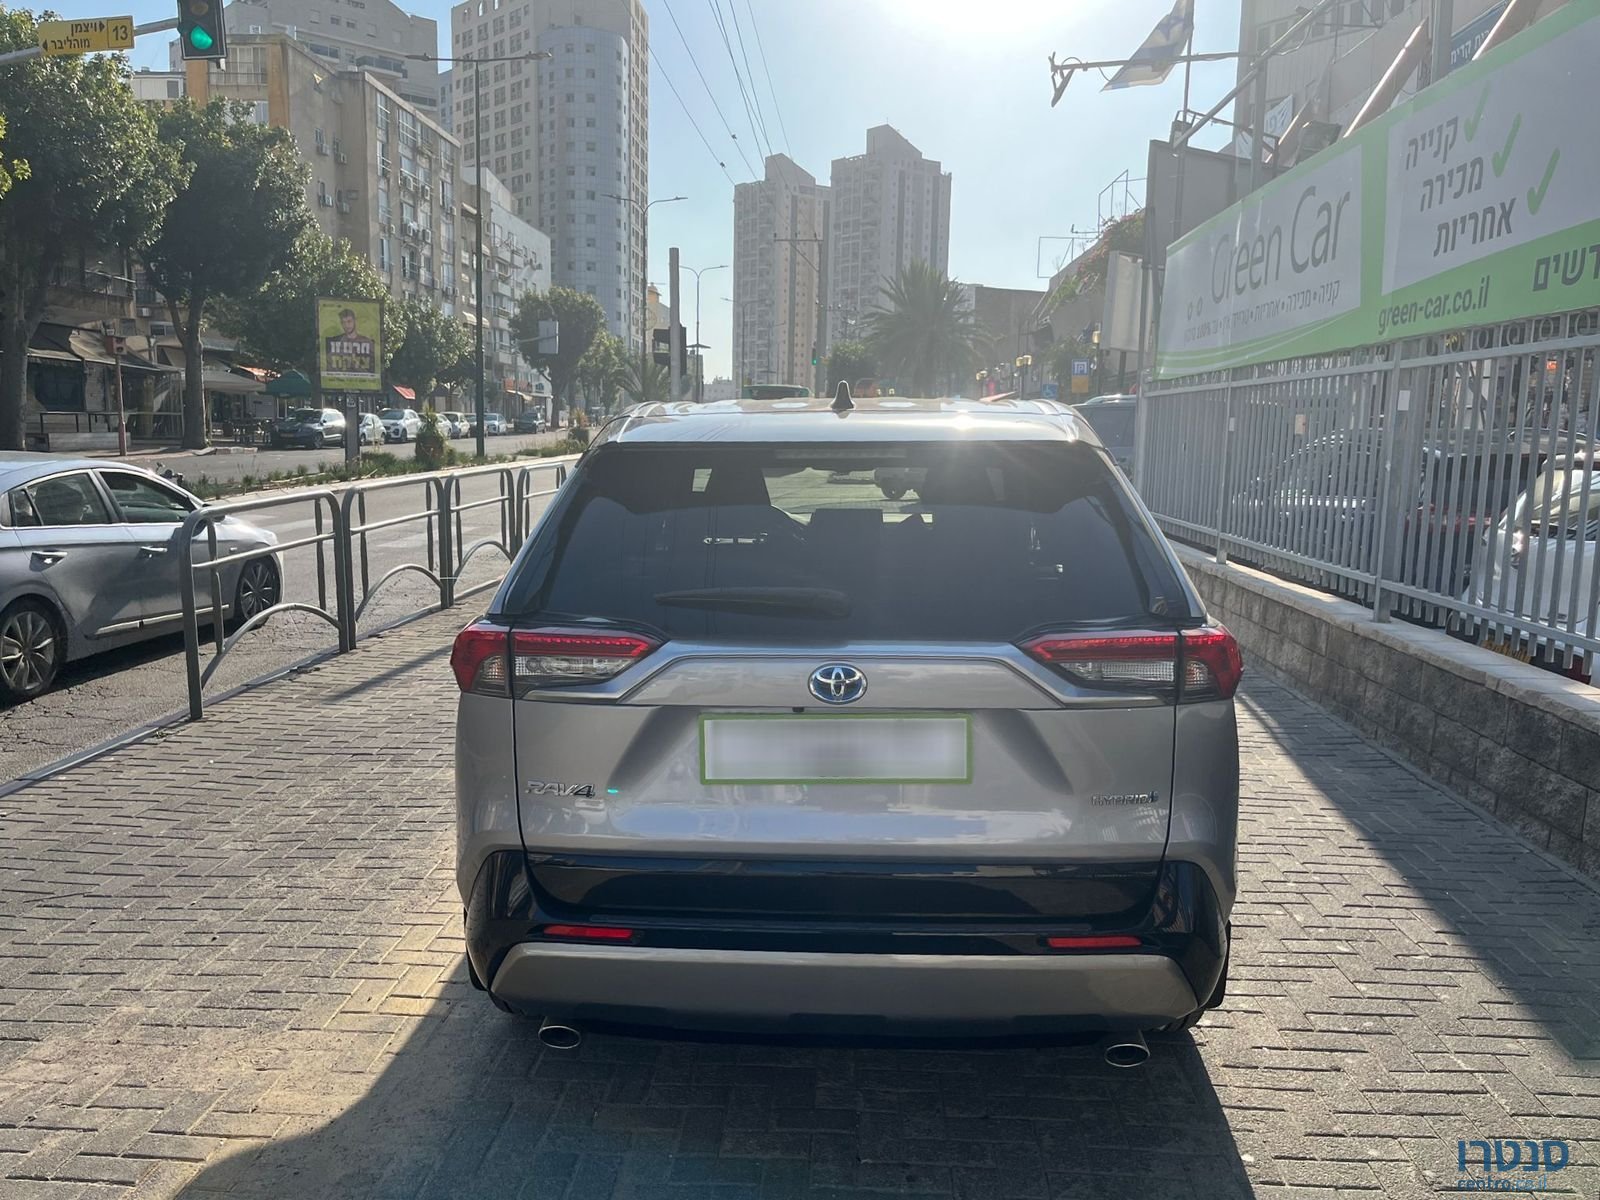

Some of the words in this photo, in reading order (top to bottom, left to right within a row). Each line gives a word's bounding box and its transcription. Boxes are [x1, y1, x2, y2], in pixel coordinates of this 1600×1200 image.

[50, 36, 90, 50] מוהליבר
[70, 22, 98, 36] ויצמן
[112, 25, 129, 41] 13
[1406, 116, 1459, 171] קנייה
[1420, 156, 1484, 213] מכירה
[1211, 225, 1282, 304] Green
[1290, 185, 1351, 274] Car
[1433, 197, 1517, 258] אחריות
[1378, 275, 1490, 336] green-car.co.il
[525, 780, 595, 798] RAV4
